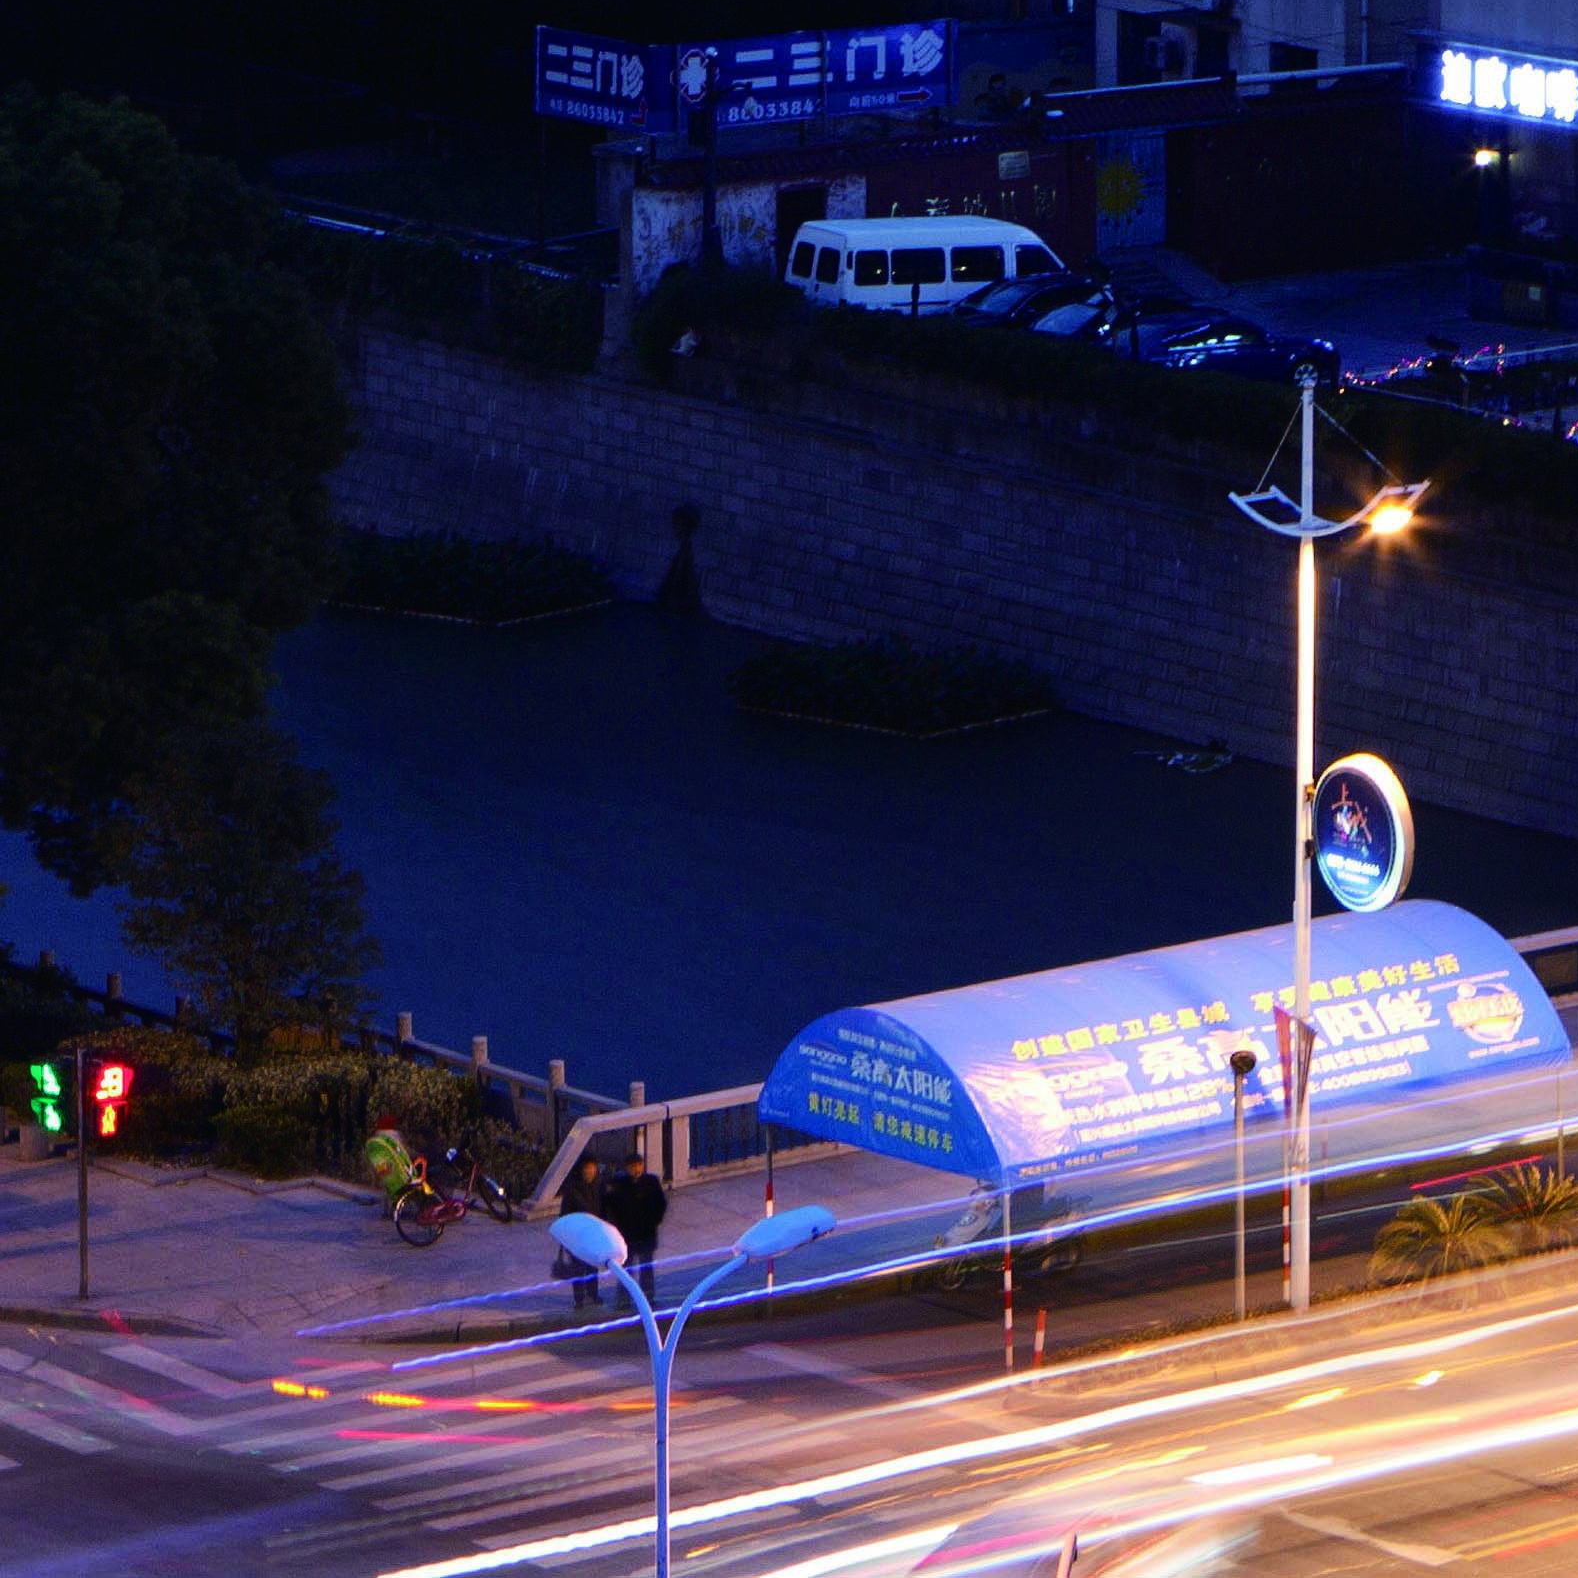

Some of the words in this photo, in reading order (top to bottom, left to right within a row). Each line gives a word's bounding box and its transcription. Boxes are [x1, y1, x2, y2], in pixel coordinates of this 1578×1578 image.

[545, 44, 645, 99] 二三门诊
[731, 29, 945, 87] 二三门诊
[1011, 1001, 1230, 1062] 创建国家卫生县城
[851, 1050, 952, 1107] 桑高太阳能
[808, 1092, 860, 1125] 黄灯亮起
